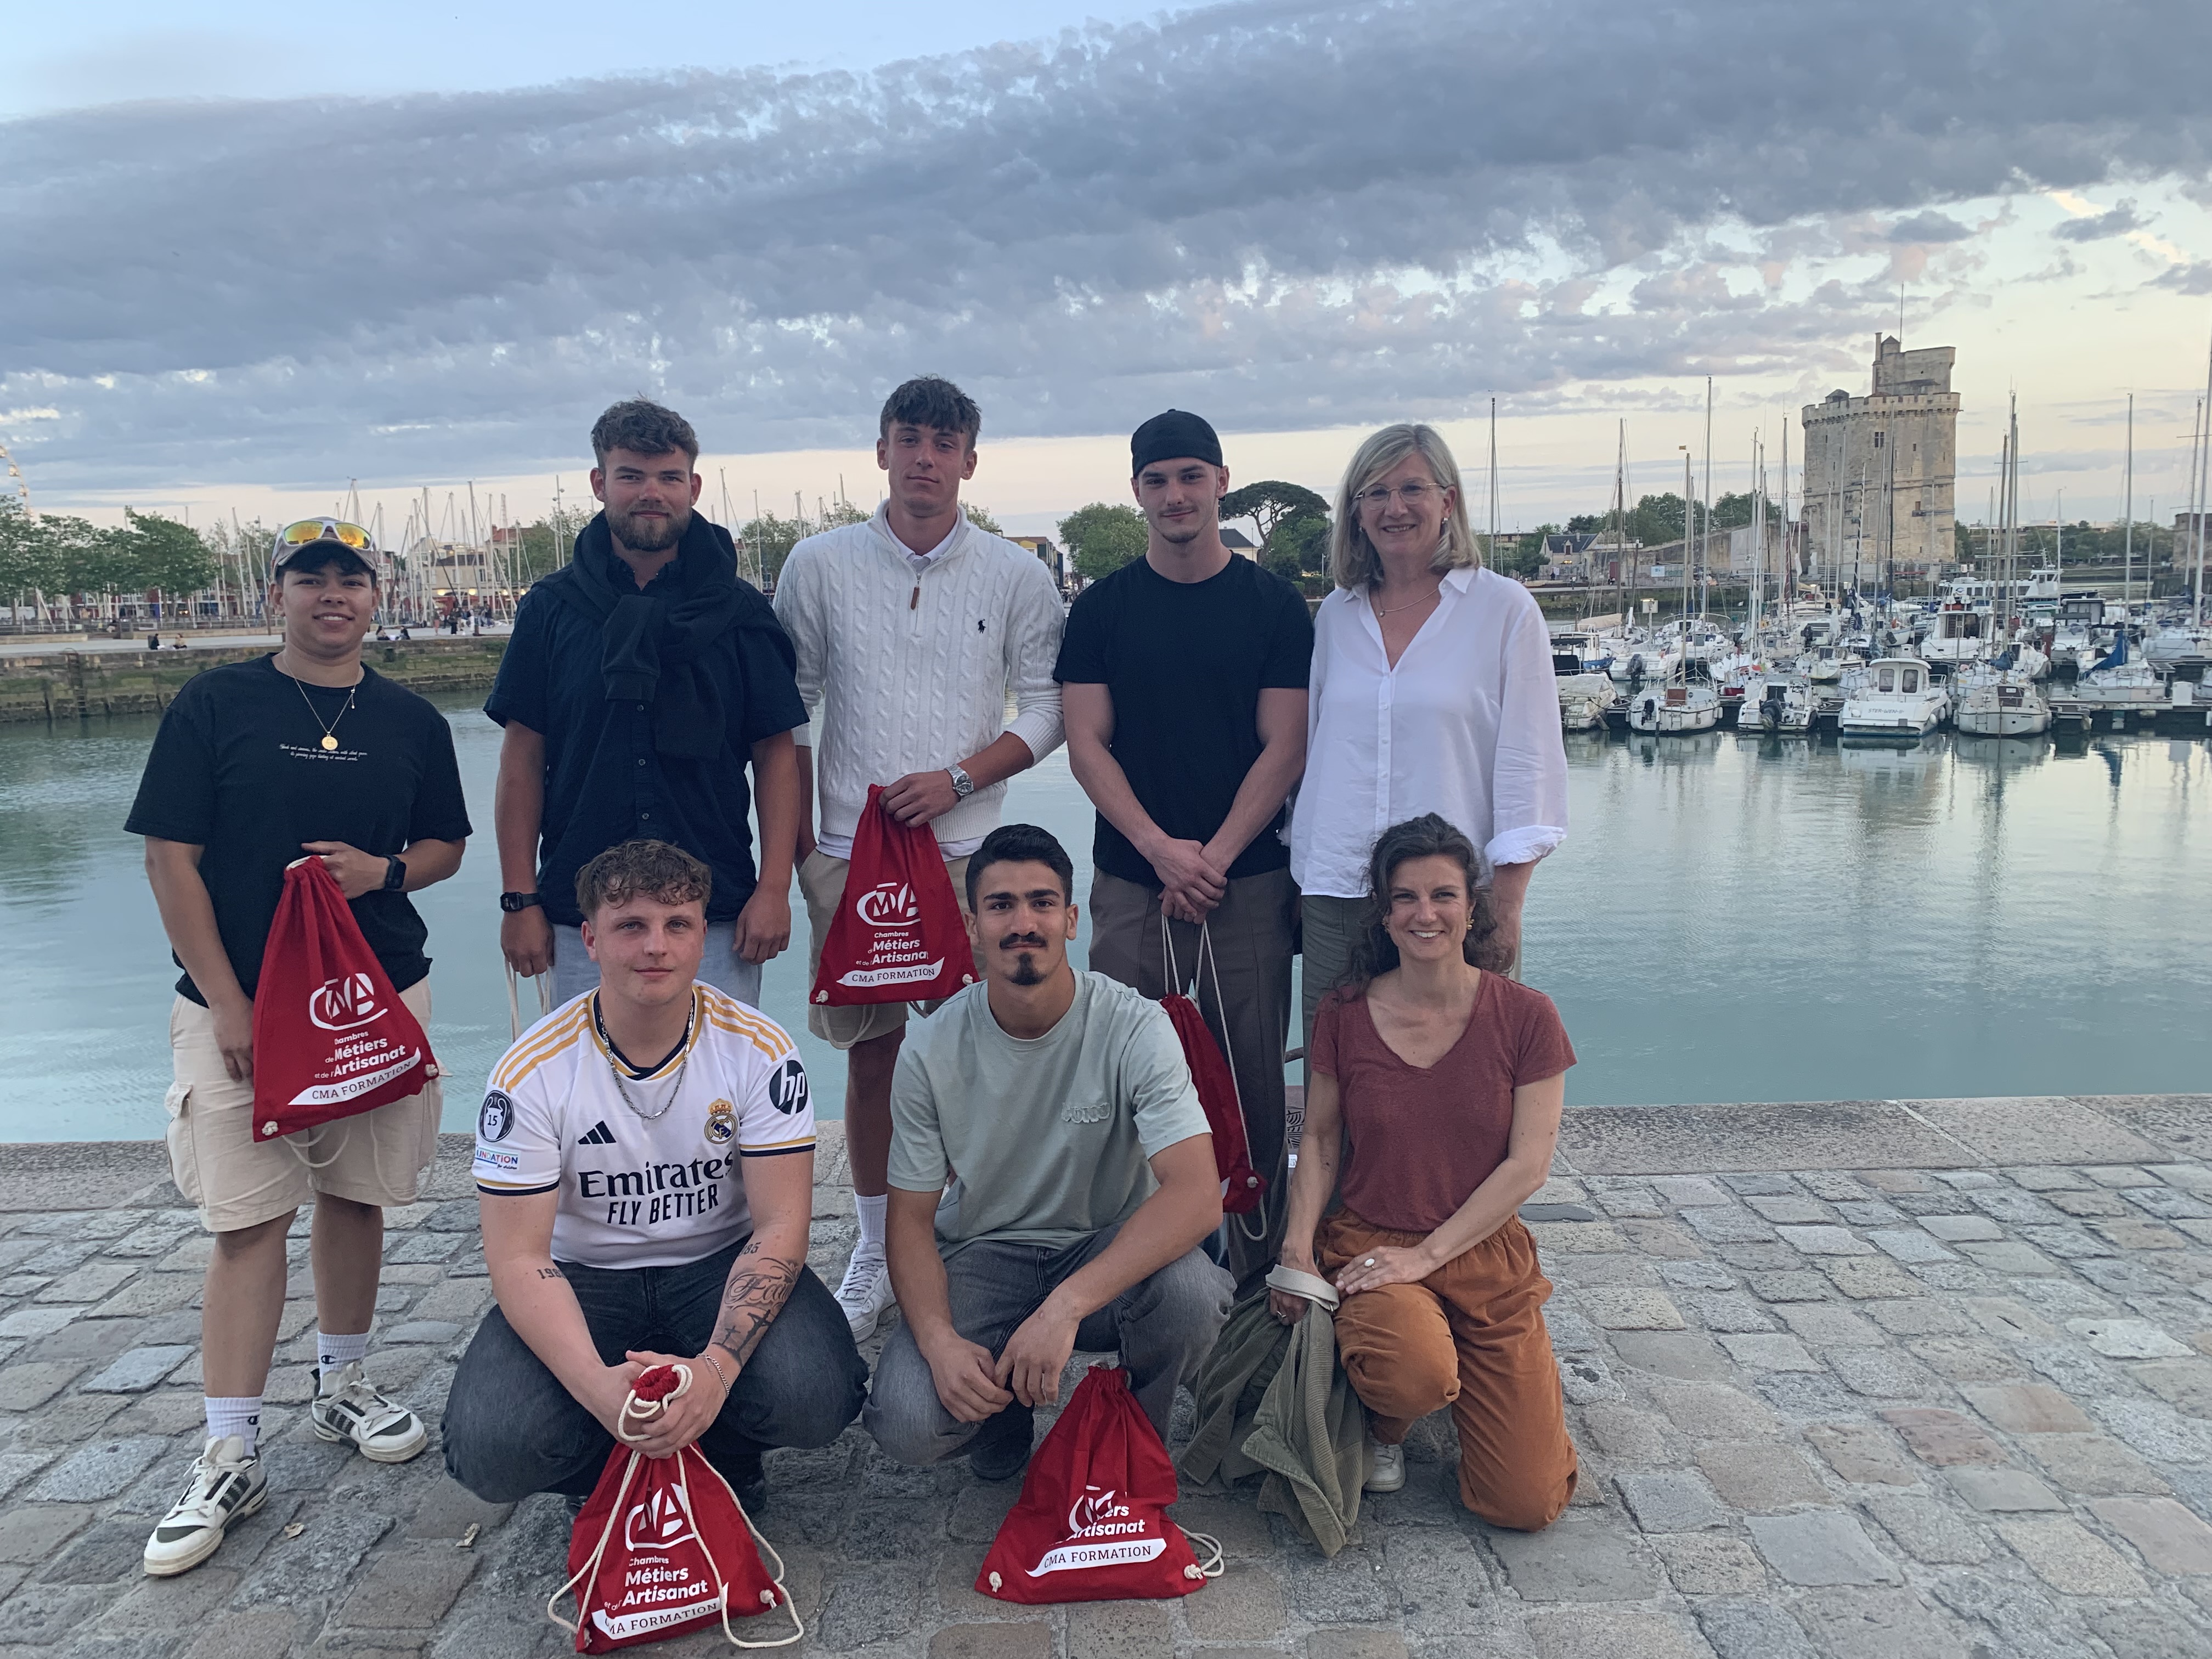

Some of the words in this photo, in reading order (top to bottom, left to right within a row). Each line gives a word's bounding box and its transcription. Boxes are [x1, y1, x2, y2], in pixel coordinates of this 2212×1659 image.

[873, 939, 921, 952] Métiers
[852, 974, 874, 983] CMA
[877, 968, 935, 981] FORMATION
[335, 1038, 388, 1062] Métiers
[312, 1089, 339, 1099] CMA
[341, 1061, 411, 1095] FORMATION
[778, 1060, 805, 1115] hp
[487, 1114, 498, 1126] 15
[578, 1151, 733, 1198] Emirates
[607, 1200, 642, 1226] FLY
[649, 1183, 719, 1224] BETTER
[1044, 1553, 1066, 1568] CMA
[1071, 1545, 1152, 1562] FORMATION
[625, 1566, 689, 1587] Métiers
[631, 1603, 716, 1630] FORMATION
